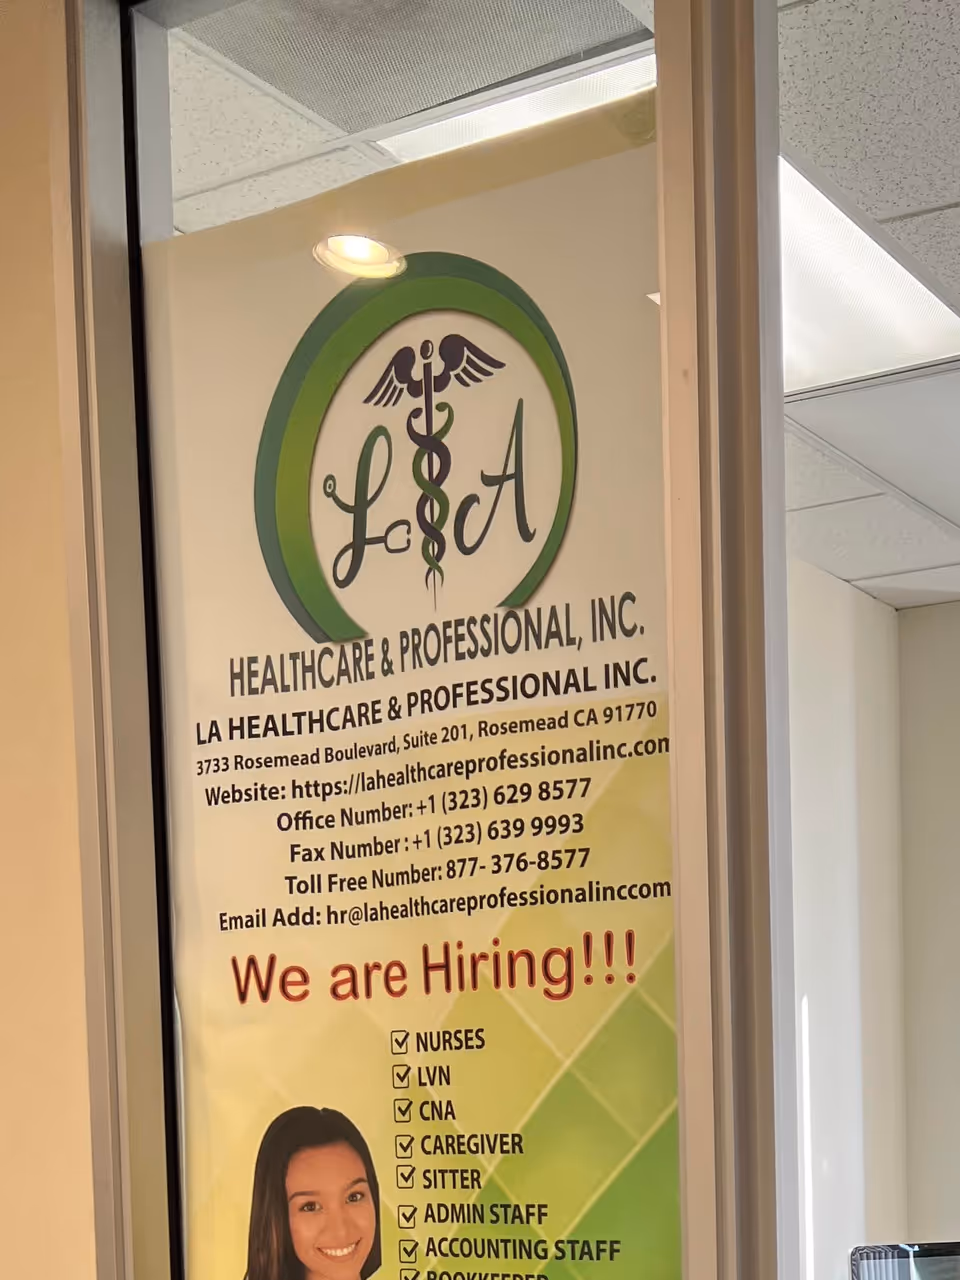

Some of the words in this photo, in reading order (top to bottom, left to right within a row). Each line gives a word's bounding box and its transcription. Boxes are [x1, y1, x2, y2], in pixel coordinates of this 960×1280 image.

[230, 639, 375, 697] HEALTHCARE
[381, 648, 394, 676] &
[400, 602, 582, 672] PROFESSIONAL,
[591, 591, 644, 643] INC.
[196, 720, 222, 745] LA
[228, 699, 382, 741] HEALTHCARE
[387, 696, 402, 720] &
[407, 665, 597, 717] PROFESSIONAL
[604, 657, 657, 689] INC.
[196, 759, 229, 776] 3733
[234, 748, 319, 771] Rosemead
[325, 736, 400, 763] Boulevard,
[404, 729, 437, 751] Suite
[441, 724, 473, 747] 201,
[479, 710, 568, 738] Rosemead
[574, 707, 598, 727] CA
[603, 701, 657, 725] 91770
[205, 782, 286, 806] Website:
[277, 812, 335, 832] Office
[340, 800, 413, 828] Number:
[417, 796, 435, 816] +1
[441, 786, 487, 816] (323)
[494, 784, 532, 805] 629
[537, 778, 591, 801] 8577
[290, 843, 325, 864] Fax
[331, 834, 400, 859] Number
[412, 830, 431, 849] +1
[438, 820, 483, 849] (323)
[487, 819, 525, 840] 639
[531, 813, 584, 836] 9993
[285, 875, 322, 895] Toll
[328, 869, 367, 892] Free
[372, 864, 442, 888] Number:
[446, 856, 485, 879] 877-
[491, 847, 590, 874] 376-8577
[219, 911, 267, 931] Email
[272, 907, 321, 928] Add:
[231, 953, 310, 1004] We
[329, 958, 407, 1000] are
[422, 929, 637, 1000] Hiring!!!
[416, 1029, 486, 1052] NURSES
[418, 1065, 451, 1087] LVN
[419, 1100, 456, 1120] CNA
[421, 1133, 523, 1155] CAREGIVER
[423, 1169, 481, 1189] SITTER
[424, 1203, 484, 1223] ADMIN
[490, 1204, 548, 1224] STAFF
[426, 1237, 548, 1260] ACCOUNTING
[554, 1239, 621, 1261] STAFF
